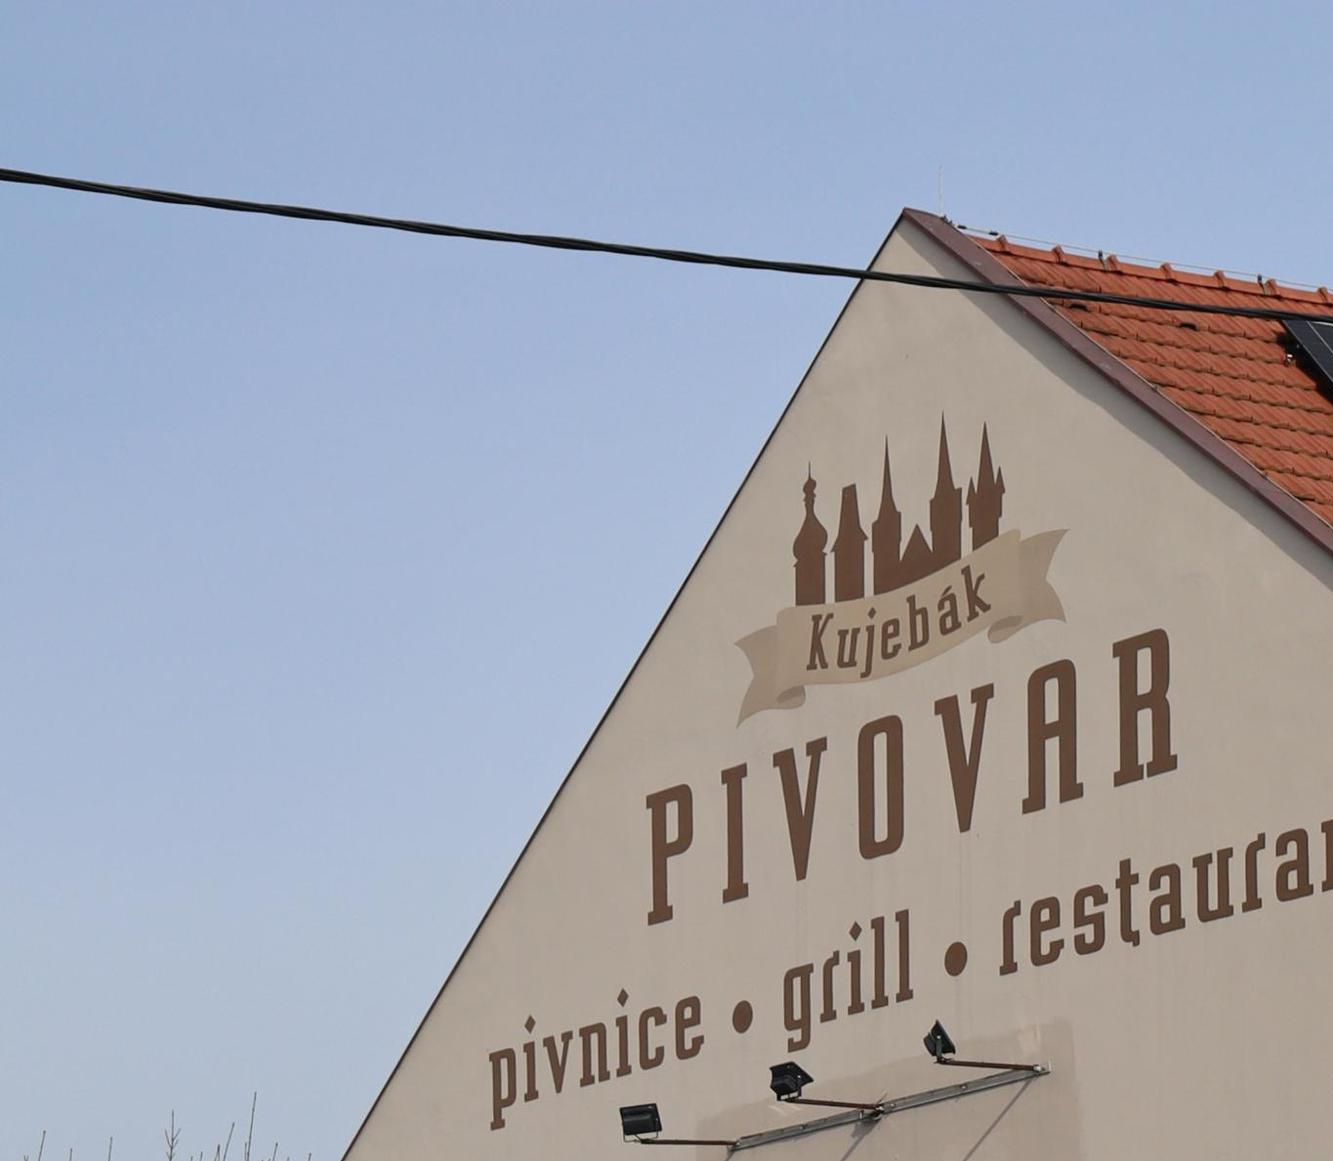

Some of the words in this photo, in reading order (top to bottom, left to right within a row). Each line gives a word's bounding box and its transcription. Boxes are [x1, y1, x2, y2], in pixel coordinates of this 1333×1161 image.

[806, 564, 992, 679] Kujebák
[645, 628, 1178, 926] PIVOVAR
[488, 988, 705, 1131] pivnice
[783, 908, 914, 1053] grill
